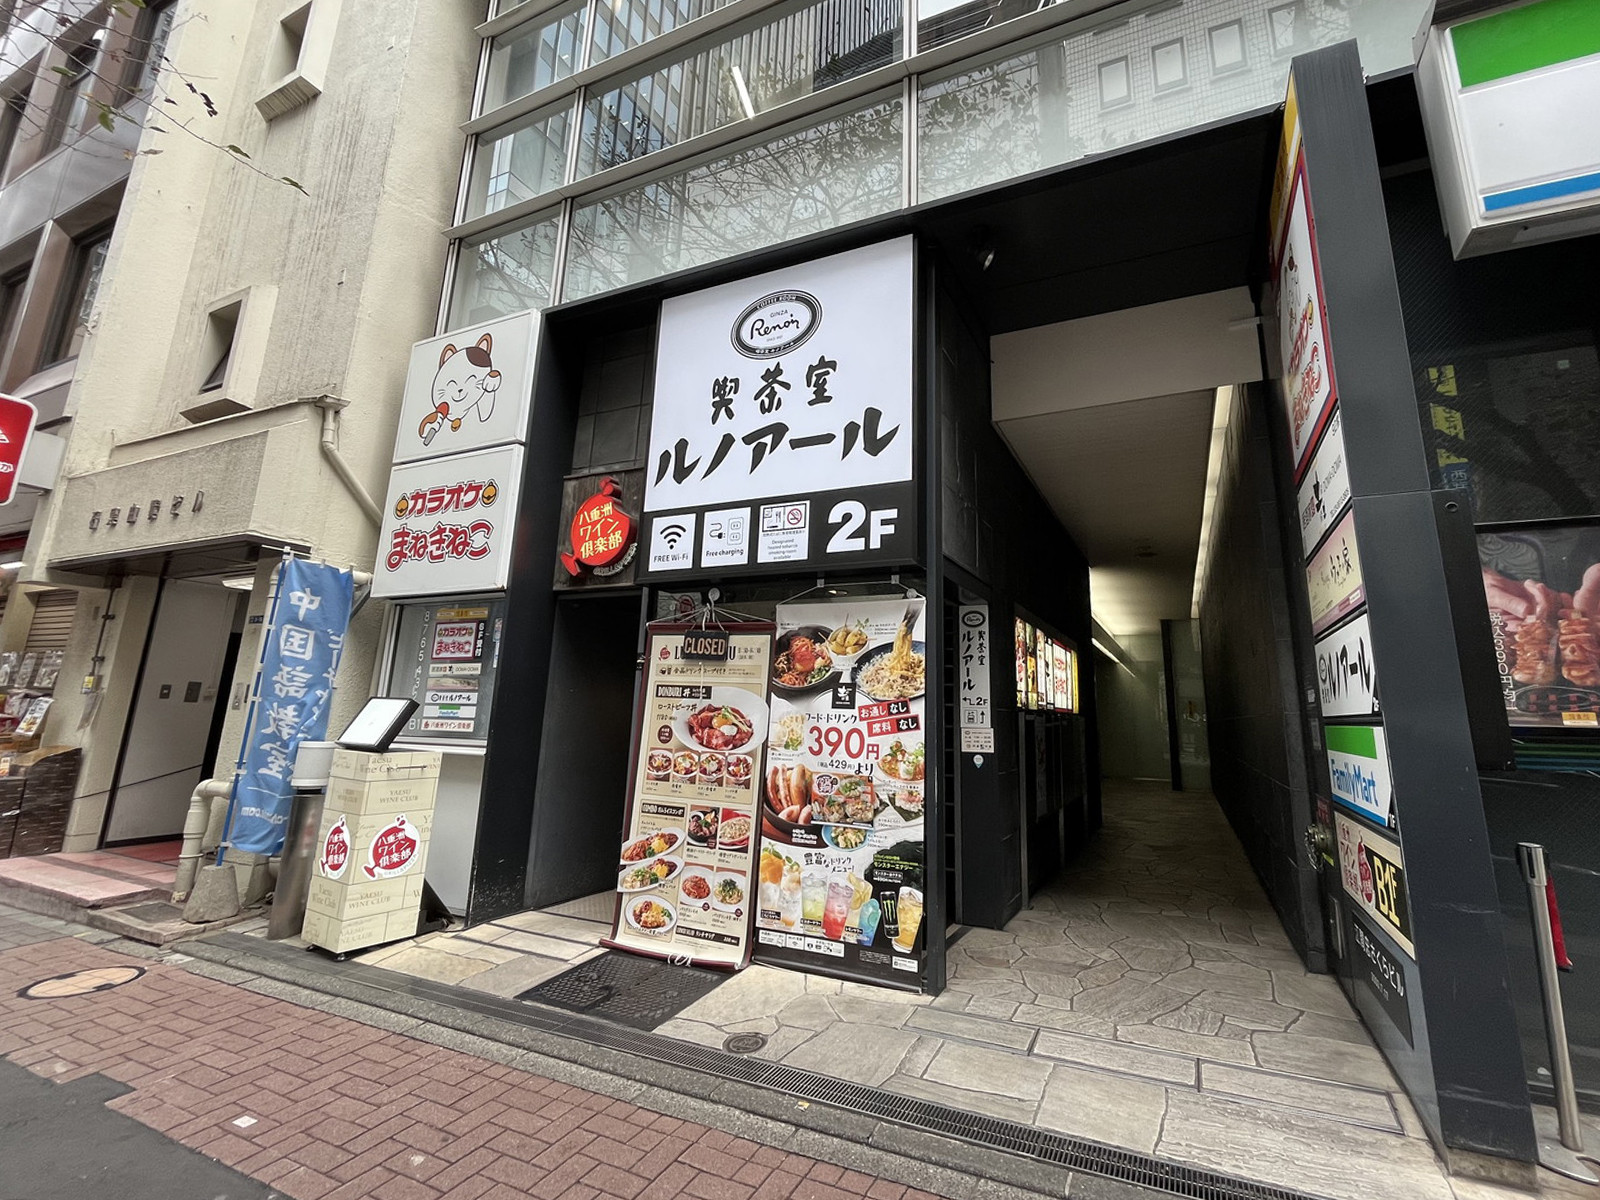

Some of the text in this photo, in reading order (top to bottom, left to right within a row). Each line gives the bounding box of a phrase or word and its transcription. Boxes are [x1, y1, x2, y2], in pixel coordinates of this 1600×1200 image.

[770, 309, 789, 318] GINZA
[711, 355, 838, 425] 喫茶室
[654, 406, 901, 487] ルノアール
[408, 481, 483, 517] カラオケ
[579, 502, 613, 526] 八重洲
[580, 518, 619, 541] ワイン
[826, 500, 898, 554] 2F
[386, 520, 493, 570] まねきねこ
[581, 530, 623, 559] 倶楽部
[706, 547, 745, 558] Free charging
[654, 553, 689, 564] FREE Wi-Fi
[424, 611, 430, 622] 8
[423, 624, 429, 635] 7
[420, 637, 426, 648] 6
[685, 637, 727, 656] CLOSED
[418, 651, 424, 662] 5
[962, 630, 976, 691] ルノアール
[1327, 637, 1371, 700] ルノアール
[657, 703, 698, 713] ローストビーフ丼
[976, 696, 989, 706] 2F
[860, 702, 908, 718] お通しなし
[806, 712, 858, 725] フード・ドリンク
[872, 718, 918, 734] 席料なし
[808, 726, 880, 760] 390円
[854, 763, 875, 777] より
[1331, 758, 1379, 807] FamilyMart
[378, 831, 406, 847] 八重洲
[328, 842, 345, 854] ワイン
[378, 839, 410, 856] ワイン
[379, 848, 412, 867] 倶楽部
[1373, 854, 1401, 928] B1F
[349, 896, 391, 909] WINE CLUB
